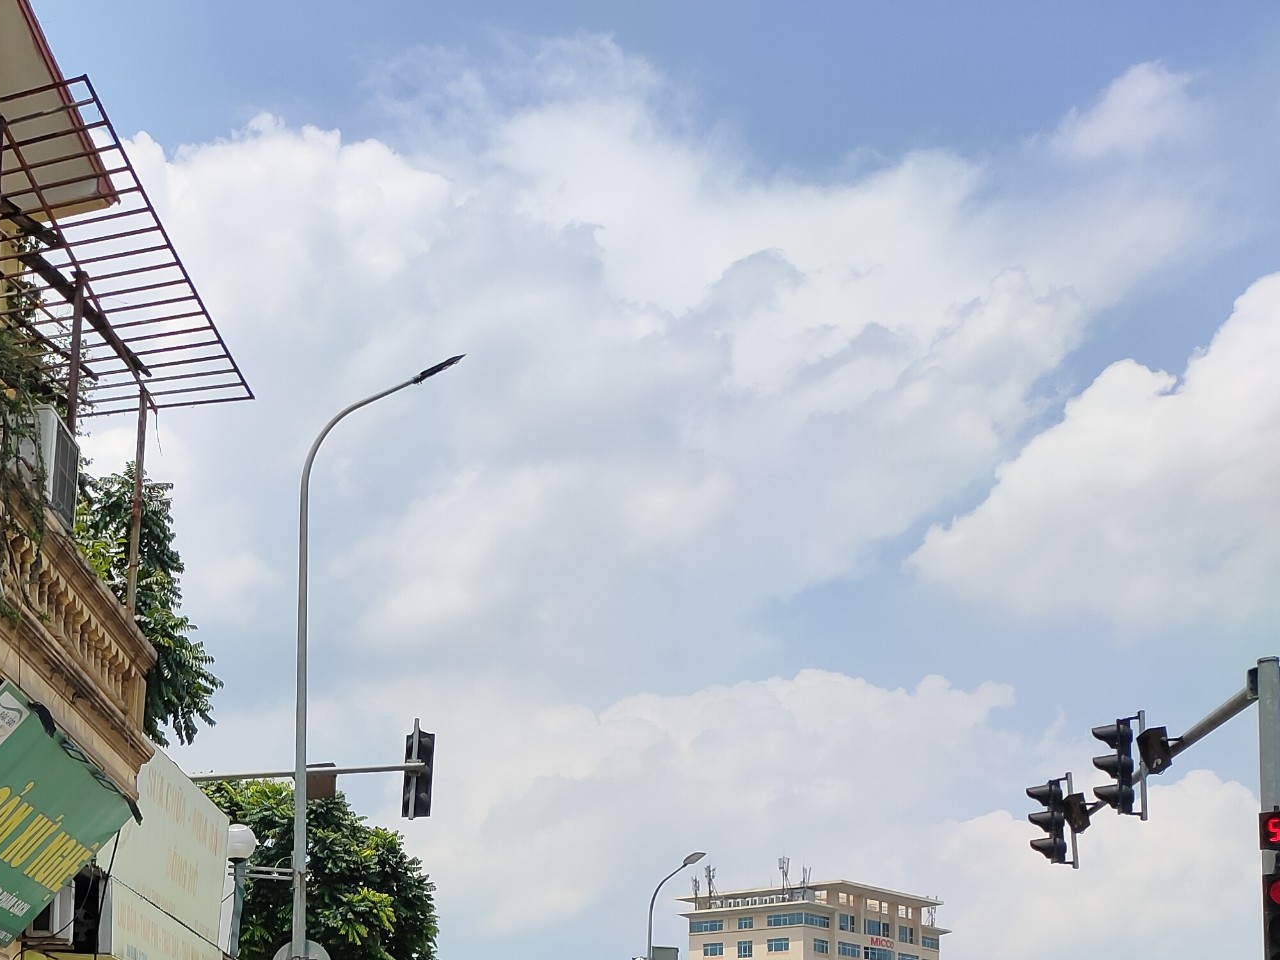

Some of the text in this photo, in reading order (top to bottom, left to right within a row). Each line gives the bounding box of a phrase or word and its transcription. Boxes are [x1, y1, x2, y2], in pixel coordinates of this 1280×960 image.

[0, 813, 65, 868] XỨ
[24, 831, 100, 901] NGHỆ
[870, 936, 895, 949] MICCO
